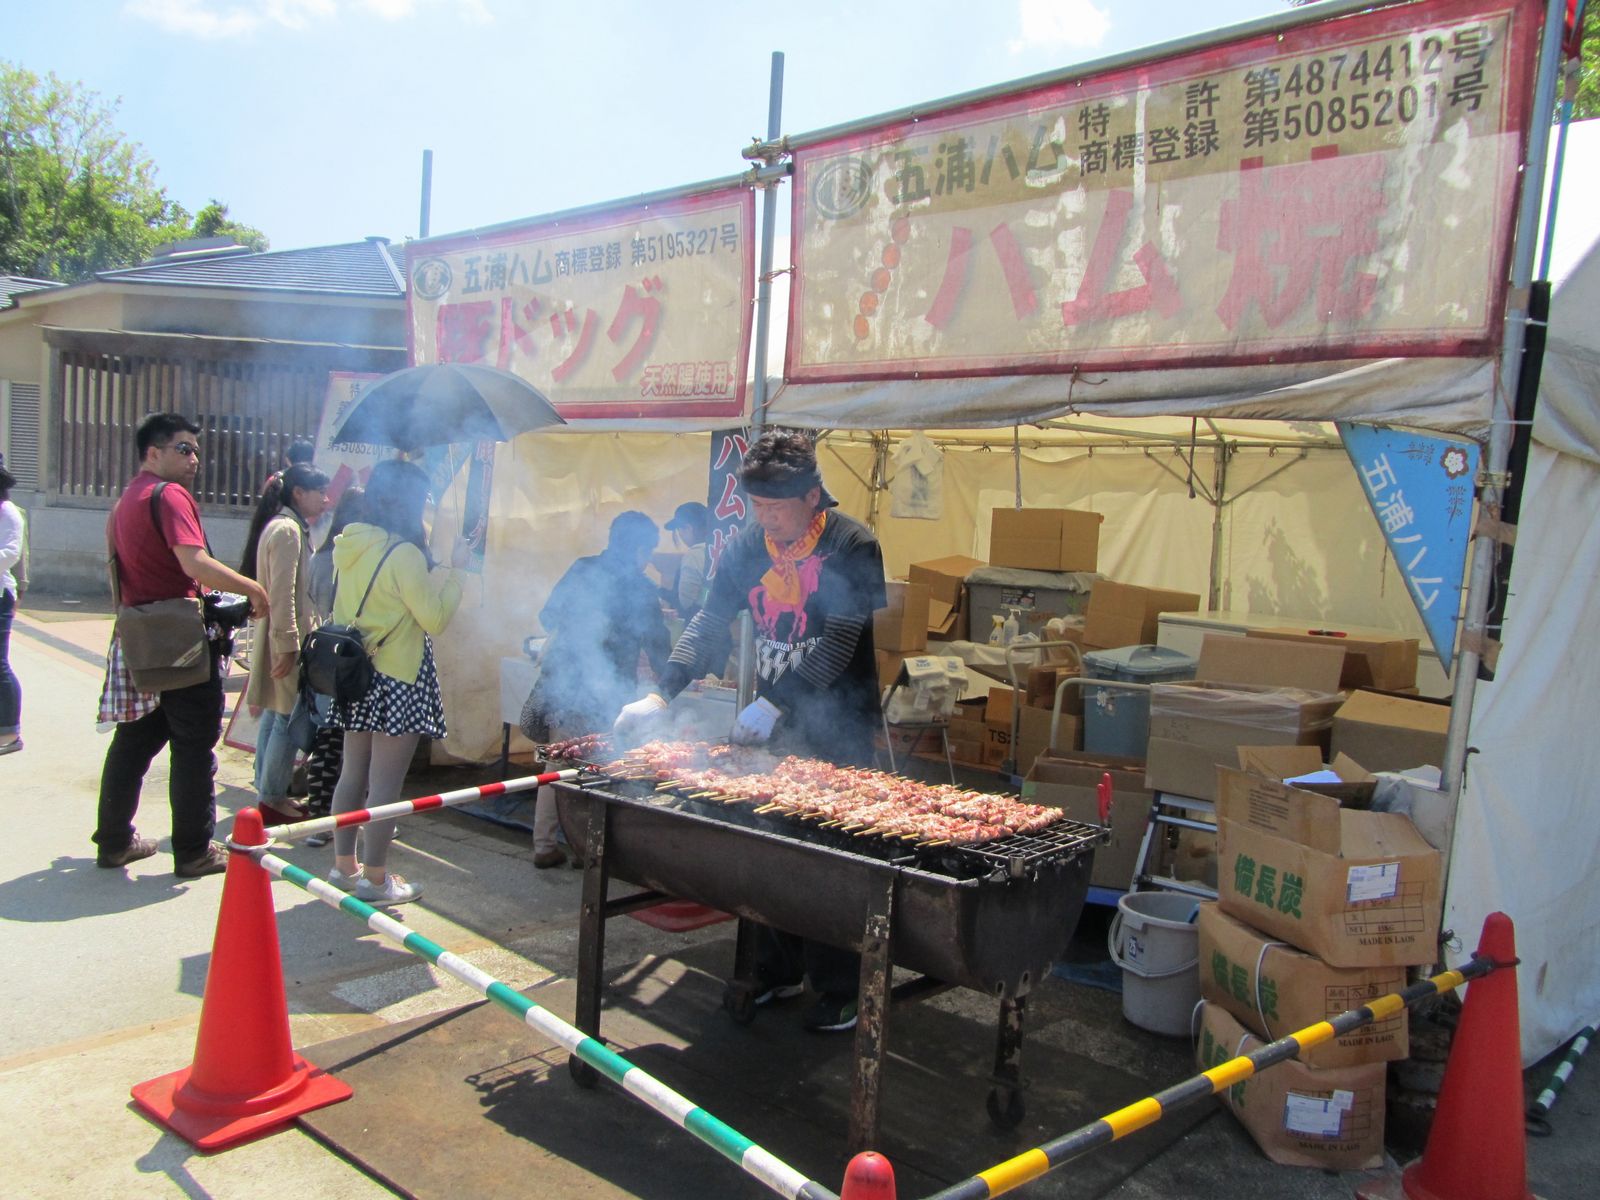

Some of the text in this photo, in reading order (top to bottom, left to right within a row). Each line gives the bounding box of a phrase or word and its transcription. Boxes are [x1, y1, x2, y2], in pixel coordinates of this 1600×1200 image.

[1243, 26, 1495, 110] 第4874412号
[891, 68, 1489, 204] 五浦ハム 商標登録 第5085201号
[462, 222, 738, 295] 五浦ハム 商標登録 第5195327号
[925, 143, 1389, 332] ハム焼
[1360, 452, 1443, 611] 五浦ハム
[1234, 852, 1304, 920] 備長炭
[1359, 935, 1415, 946] MADE IN LAOS
